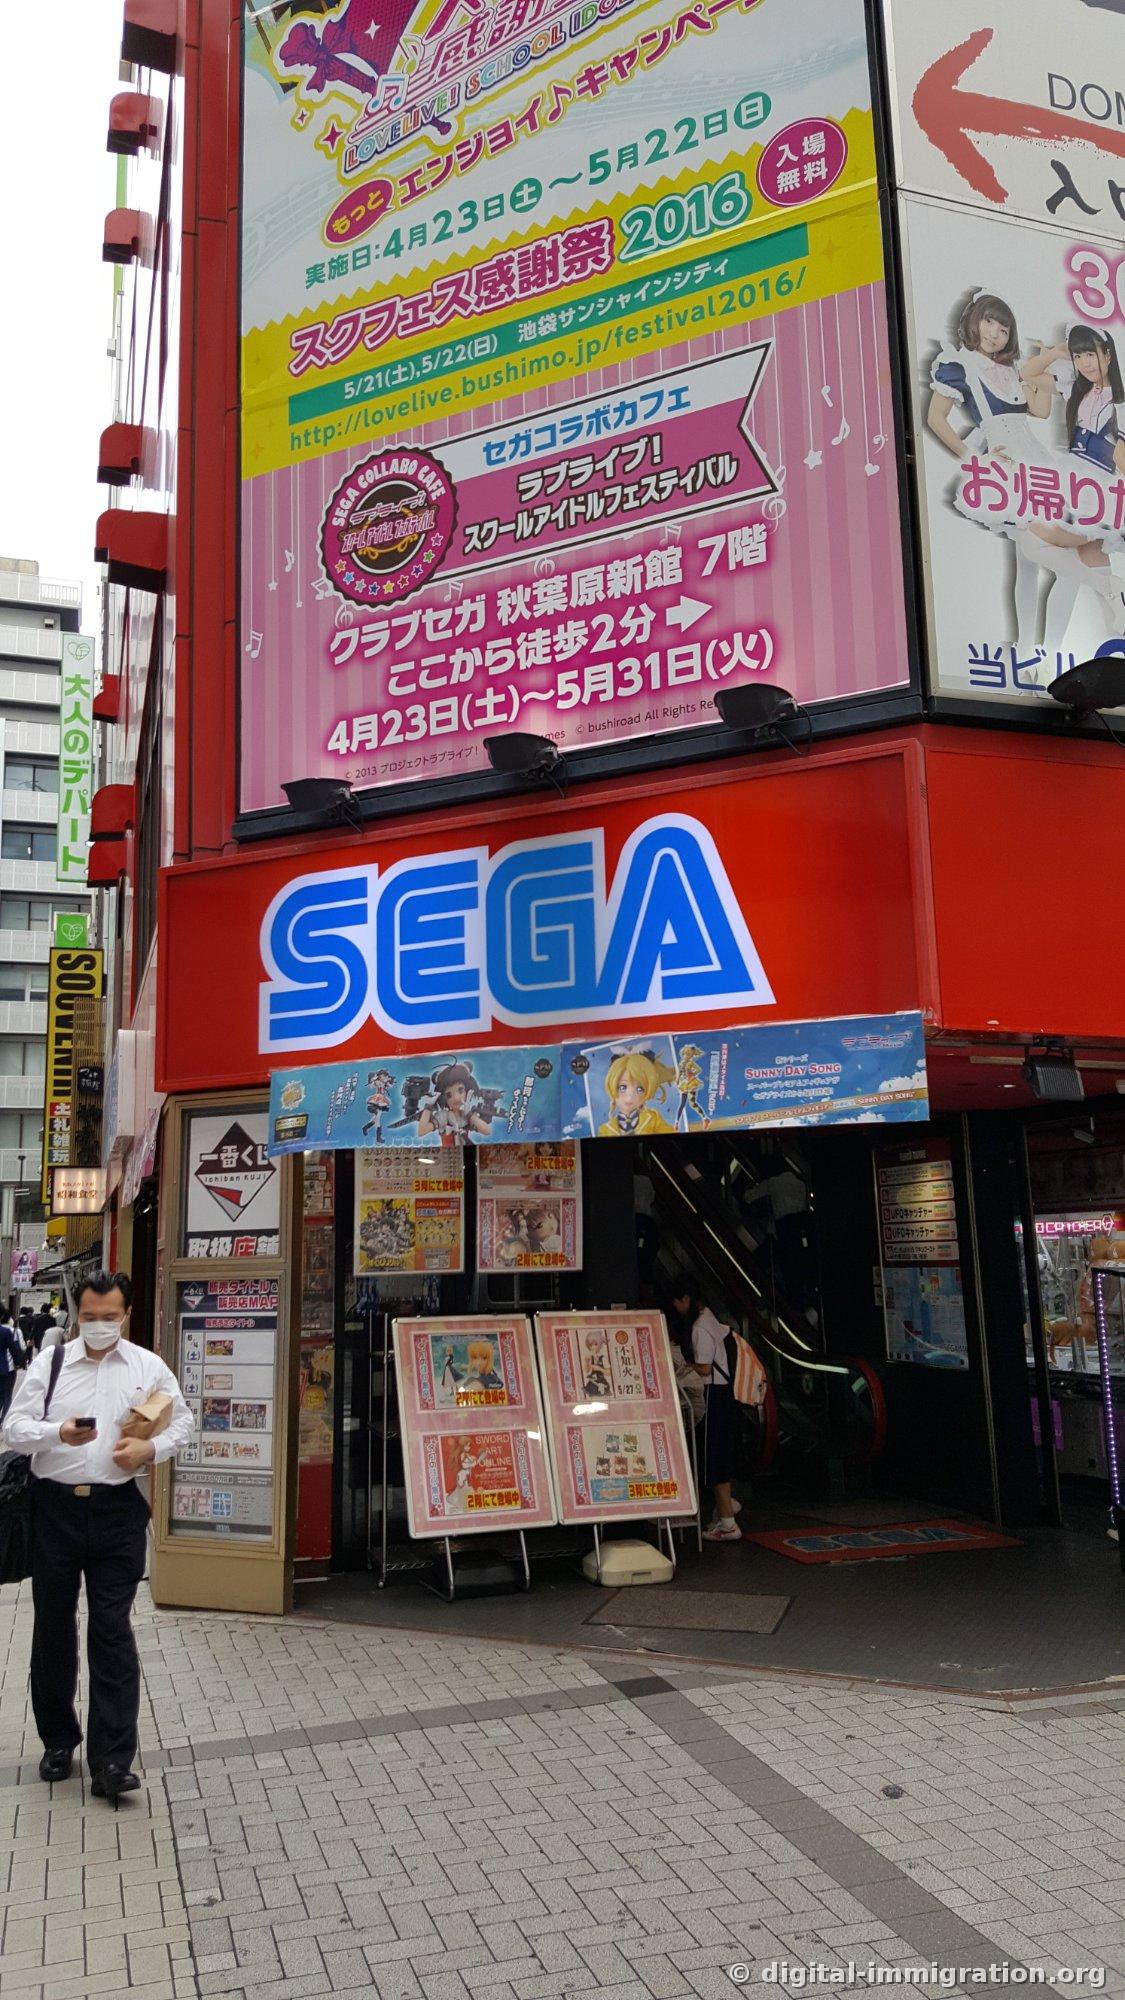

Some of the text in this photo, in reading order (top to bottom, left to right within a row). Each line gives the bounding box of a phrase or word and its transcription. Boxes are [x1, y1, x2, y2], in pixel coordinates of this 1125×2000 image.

[466, 27, 566, 100] SCHOOL
[776, 131, 827, 168] 入場
[776, 158, 829, 195] 無料
[332, 189, 385, 235] もっと
[288, 170, 752, 377] スクフェス感謝祭 2016
[289, 266, 807, 450] http://lovelive.bushimo.jp/festival2016/
[343, 259, 729, 400] 5/21(土),5/22(日) 池袋サンシャインシティ
[483, 386, 691, 466] セガコラボカフェ
[332, 458, 446, 527] SEGA COLLABO CAFE
[463, 453, 739, 554] スクールアイドルフェスティバル
[518, 433, 662, 501] ラブライブ!
[329, 523, 769, 664] クラブセガ 秋葉原新館 7階
[387, 603, 656, 696] ここから徒歩2分
[61, 673, 92, 872] 大人のデパート
[355, 767, 377, 780] 2013
[588, 714, 641, 735] bushiroad
[645, 707, 660, 721] All
[662, 701, 697, 718] Rights
[258, 812, 776, 1055] SEGA
[745, 1063, 841, 1079] SUNNY DAY SONG
[188, 1235, 280, 1257] 取扱店舗
[475, 1434, 510, 1444] SWORD
[477, 1456, 512, 1467] ONLINE
[485, 1446, 502, 1455] ART
